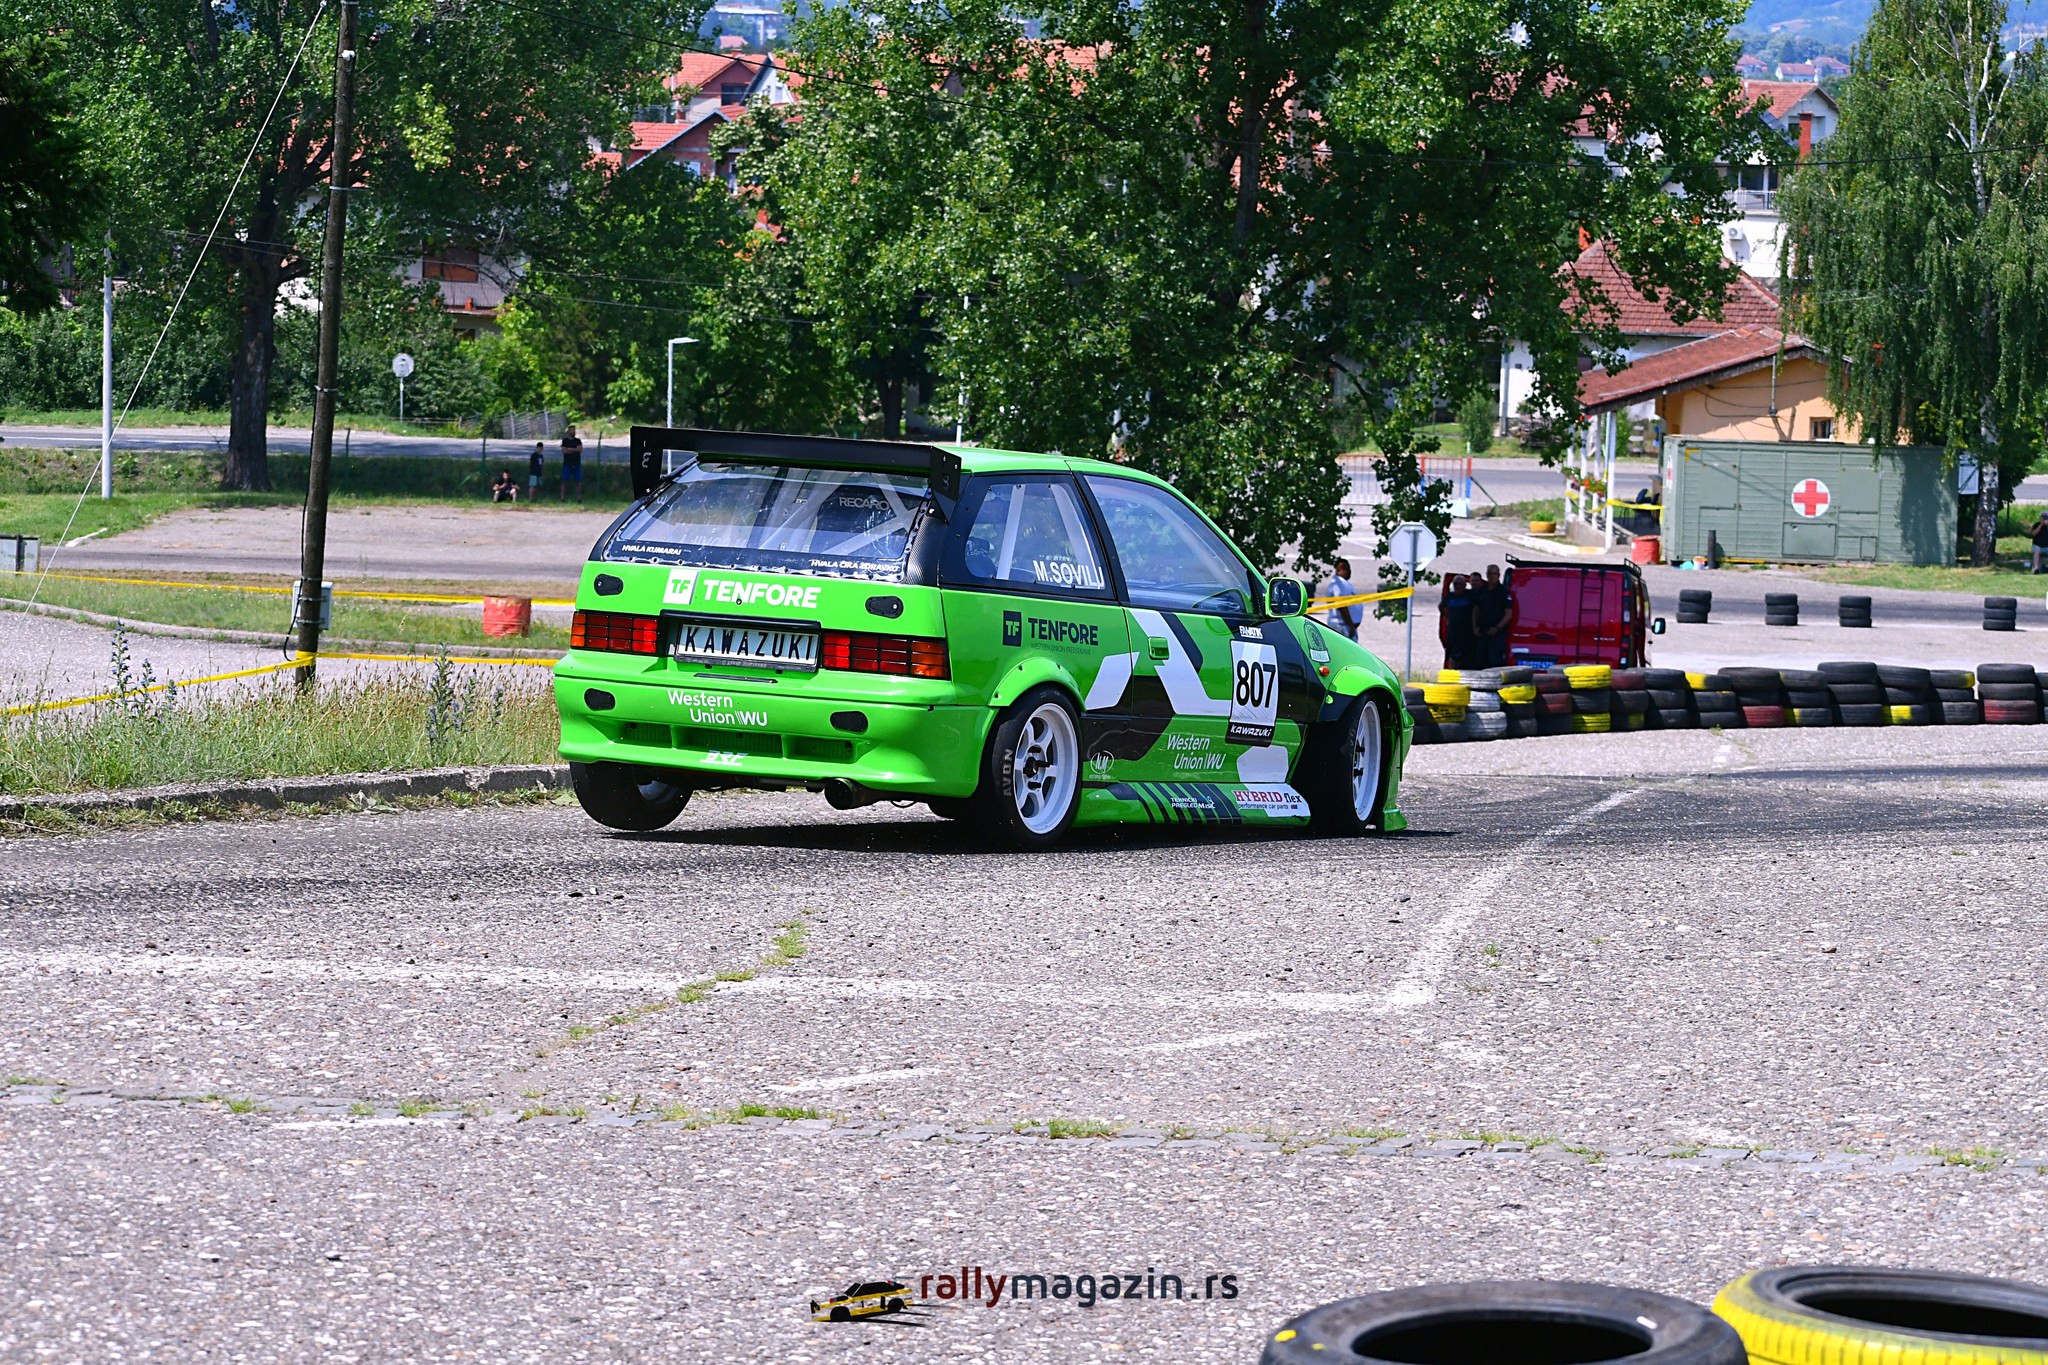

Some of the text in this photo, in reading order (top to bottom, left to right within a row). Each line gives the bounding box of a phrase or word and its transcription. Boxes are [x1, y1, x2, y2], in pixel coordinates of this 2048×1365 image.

[839, 497, 889, 511] RECARO
[622, 544, 646, 552] HVALA
[810, 560, 838, 568] HVALA
[671, 579, 822, 609] TF TENFORE
[1005, 617, 1099, 646] TF TENFORE
[684, 626, 813, 660] KAWAZUKI
[1236, 659, 1277, 709] 807
[667, 689, 733, 708] Western
[689, 707, 735, 725] Union
[1167, 734, 1211, 751] Western
[1002, 748, 1014, 797] AVON
[1232, 790, 1303, 804] HYBRID flex
[1238, 802, 1268, 810] performance
